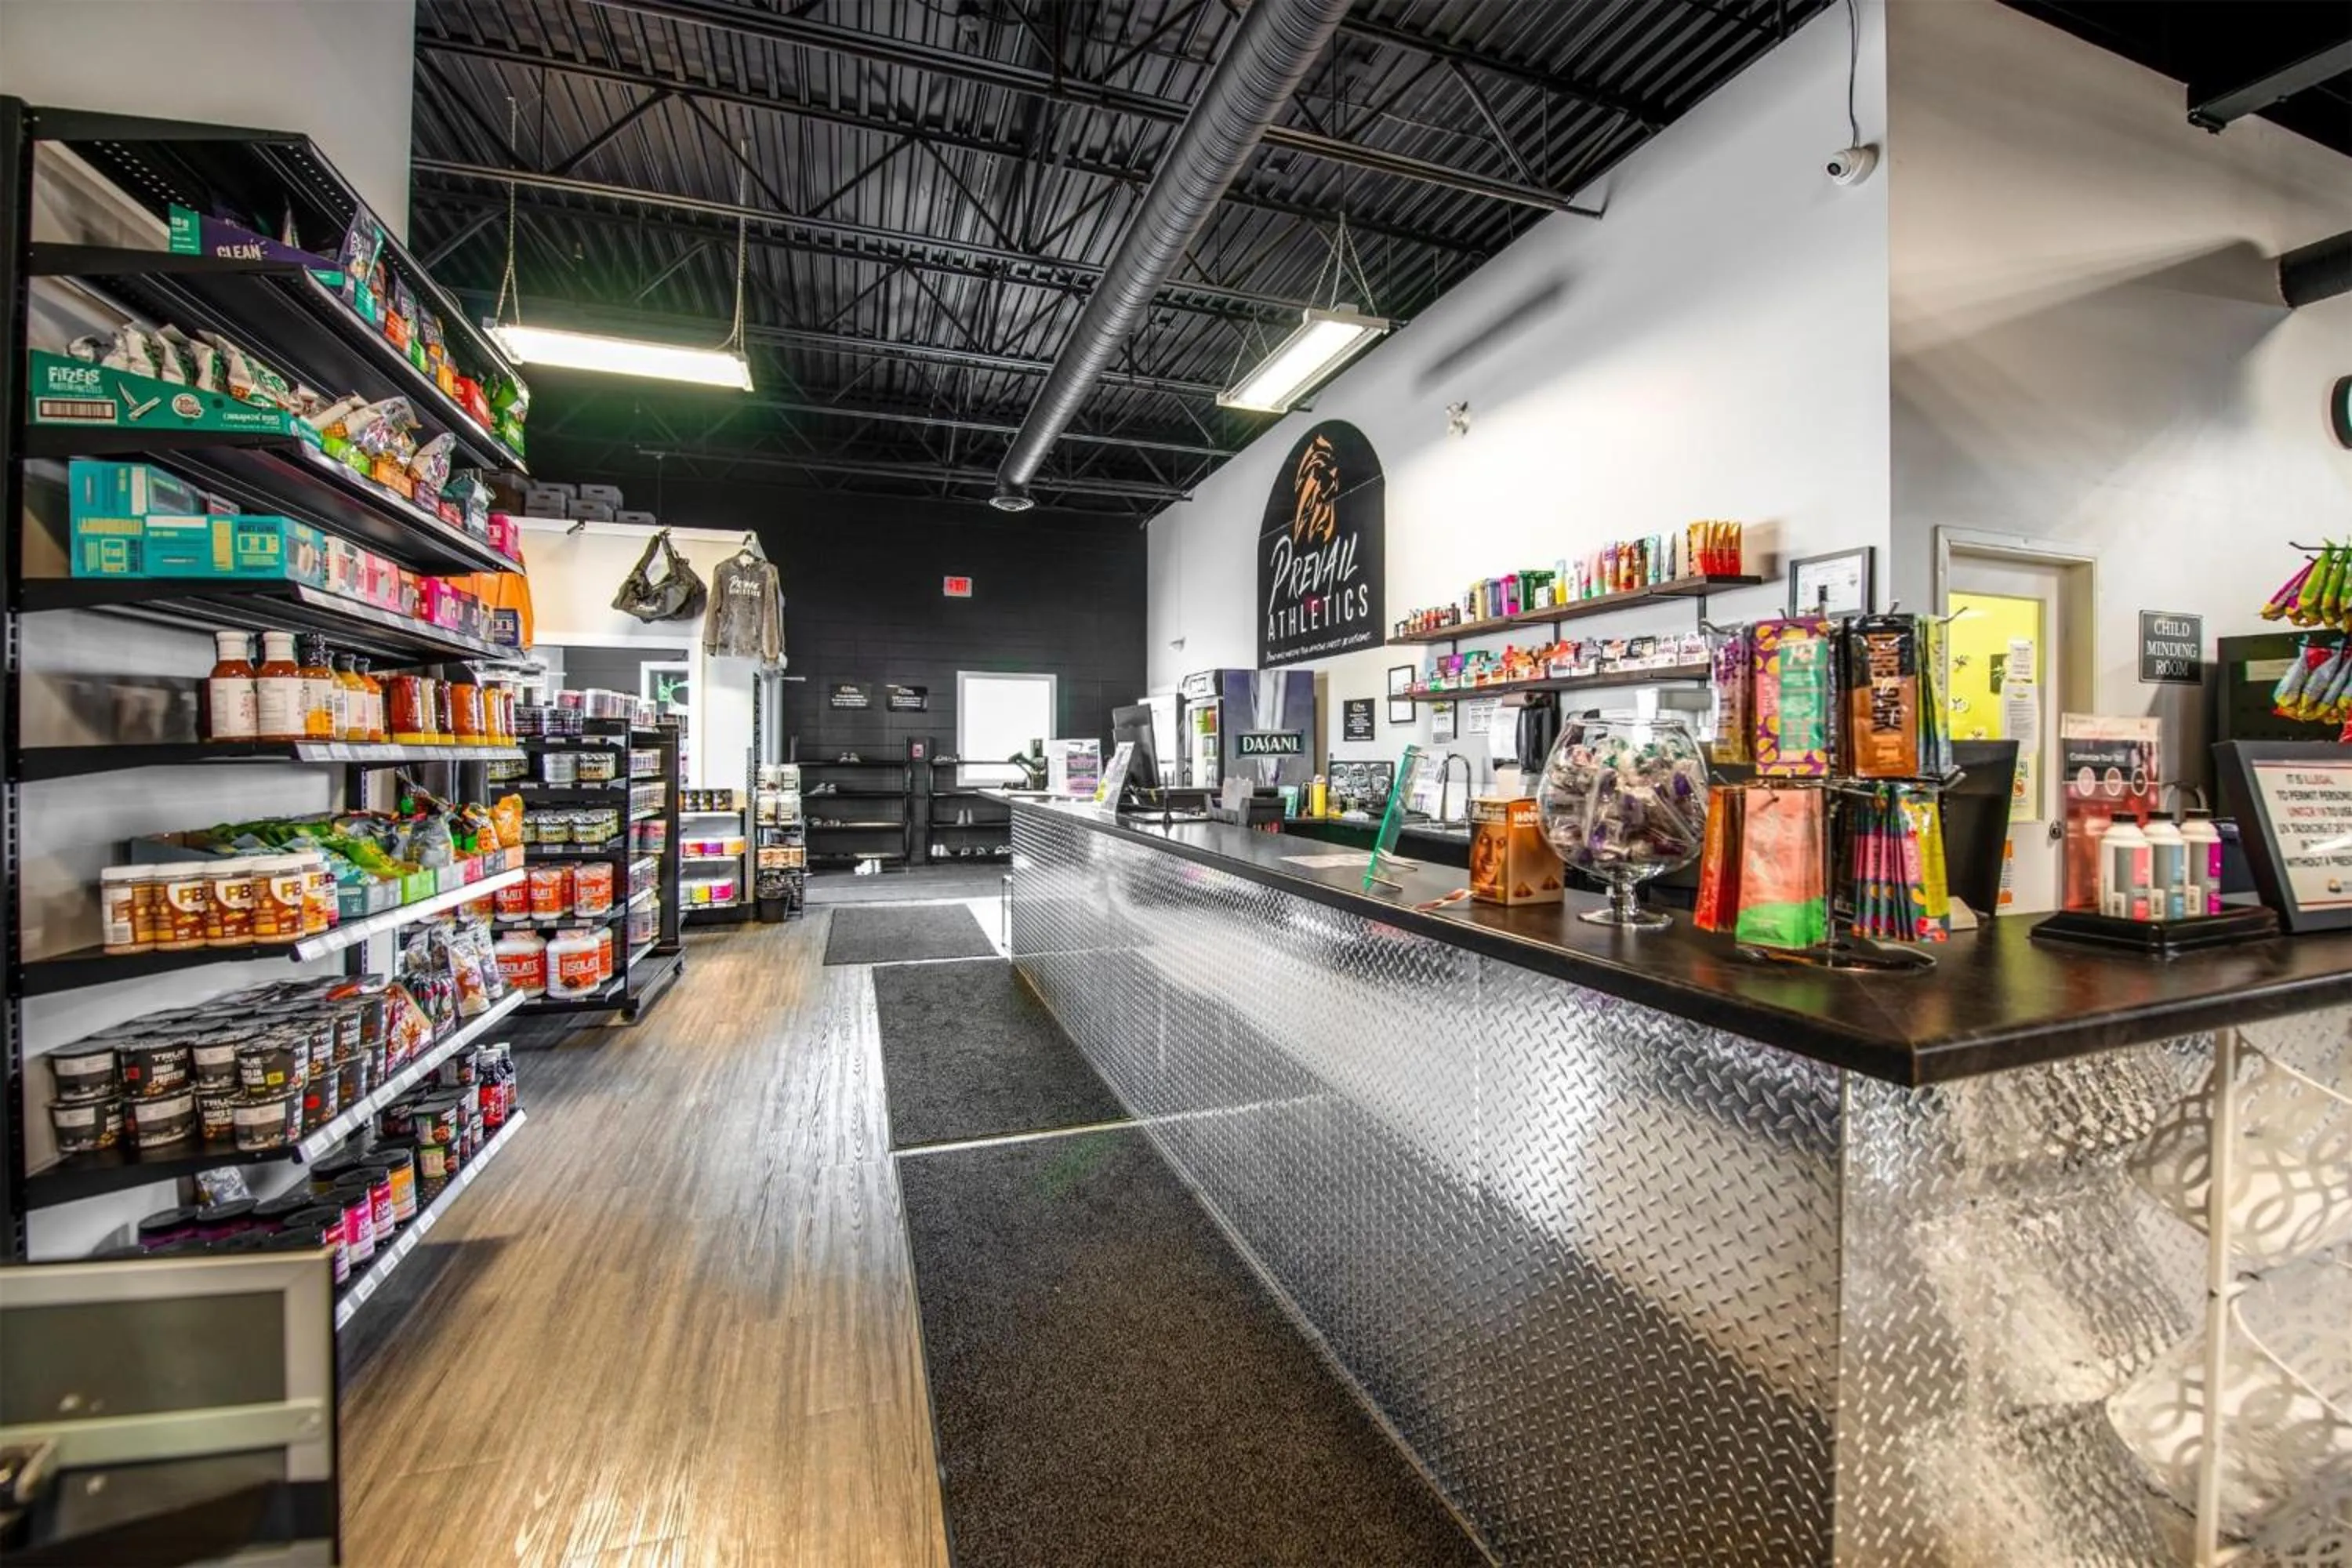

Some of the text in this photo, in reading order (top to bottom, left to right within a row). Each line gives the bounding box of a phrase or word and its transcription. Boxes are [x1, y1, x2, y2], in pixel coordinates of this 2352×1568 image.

[216, 244, 261, 261] CLEAN
[1268, 532, 1359, 615] PREVAIL
[1268, 583, 1368, 642] ATHLETICS
[2154, 619, 2190, 637] CHILD
[2146, 639, 2198, 659] MINDING
[2154, 659, 2189, 677] ROOM
[1242, 735, 1301, 754] DASANI
[178, 887, 204, 904] PB
[225, 884, 252, 901] PB
